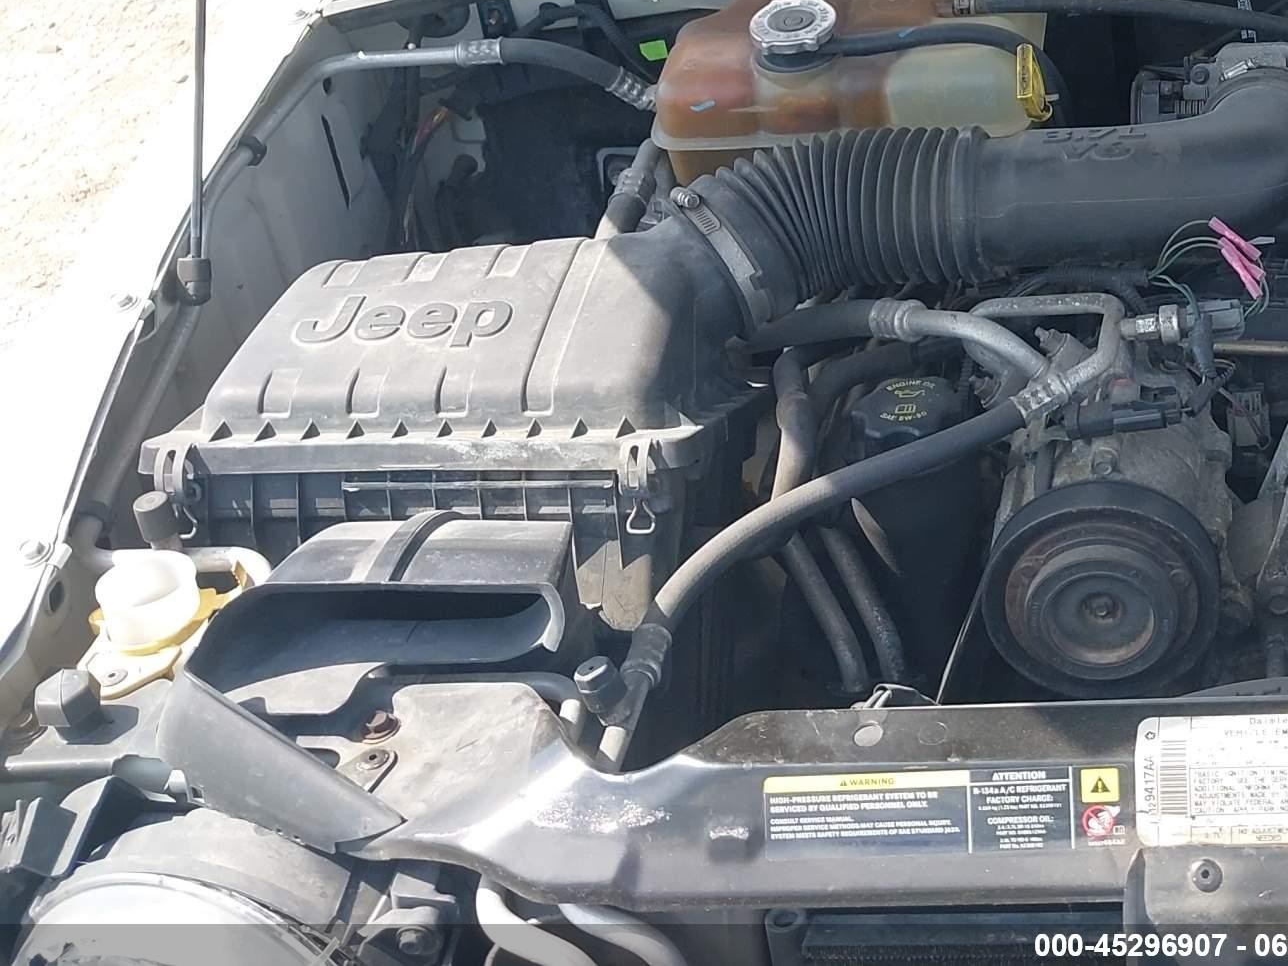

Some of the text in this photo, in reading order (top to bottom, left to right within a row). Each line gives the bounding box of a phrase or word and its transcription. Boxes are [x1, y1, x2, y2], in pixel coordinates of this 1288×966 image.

[294, 294, 514, 348] Jeep
[992, 770, 1046, 781] ATTENTION
[850, 778, 895, 786] WARNING
[1016, 784, 1067, 793] REFRIGERANT
[916, 791, 926, 799] TO
[986, 795, 1020, 804] FACTORY
[808, 804, 818, 812] BY
[819, 803, 859, 812] QUALIFIED
[987, 816, 1038, 825] COMPRESSOR
